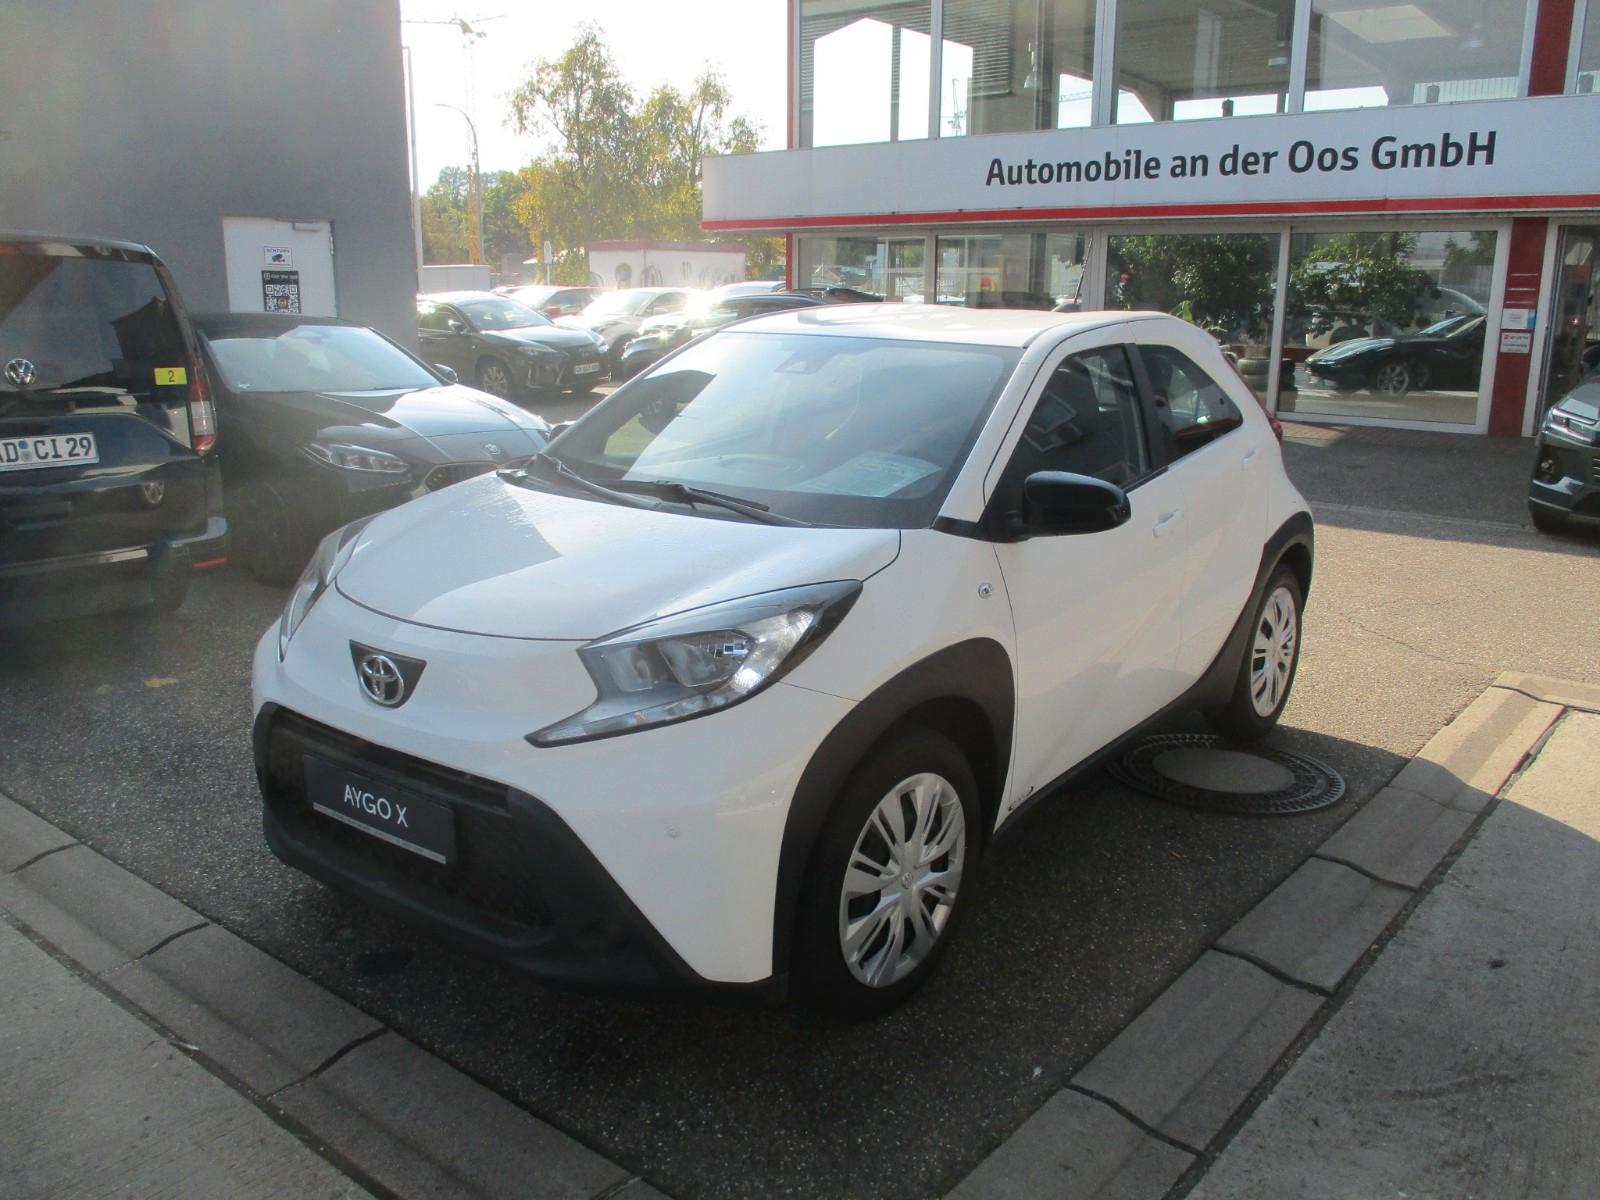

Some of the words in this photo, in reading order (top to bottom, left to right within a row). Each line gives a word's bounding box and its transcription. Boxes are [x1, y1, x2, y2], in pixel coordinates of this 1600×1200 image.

[985, 149, 1161, 186] Automobile
[1170, 153, 1209, 178] an
[1219, 144, 1278, 176] der
[1288, 140, 1359, 173] Oos
[1371, 131, 1497, 170] GmbH
[167, 369, 176, 383] 2
[0, 442, 19, 463] D
[343, 784, 392, 820] AYGO
[395, 803, 409, 828] X
